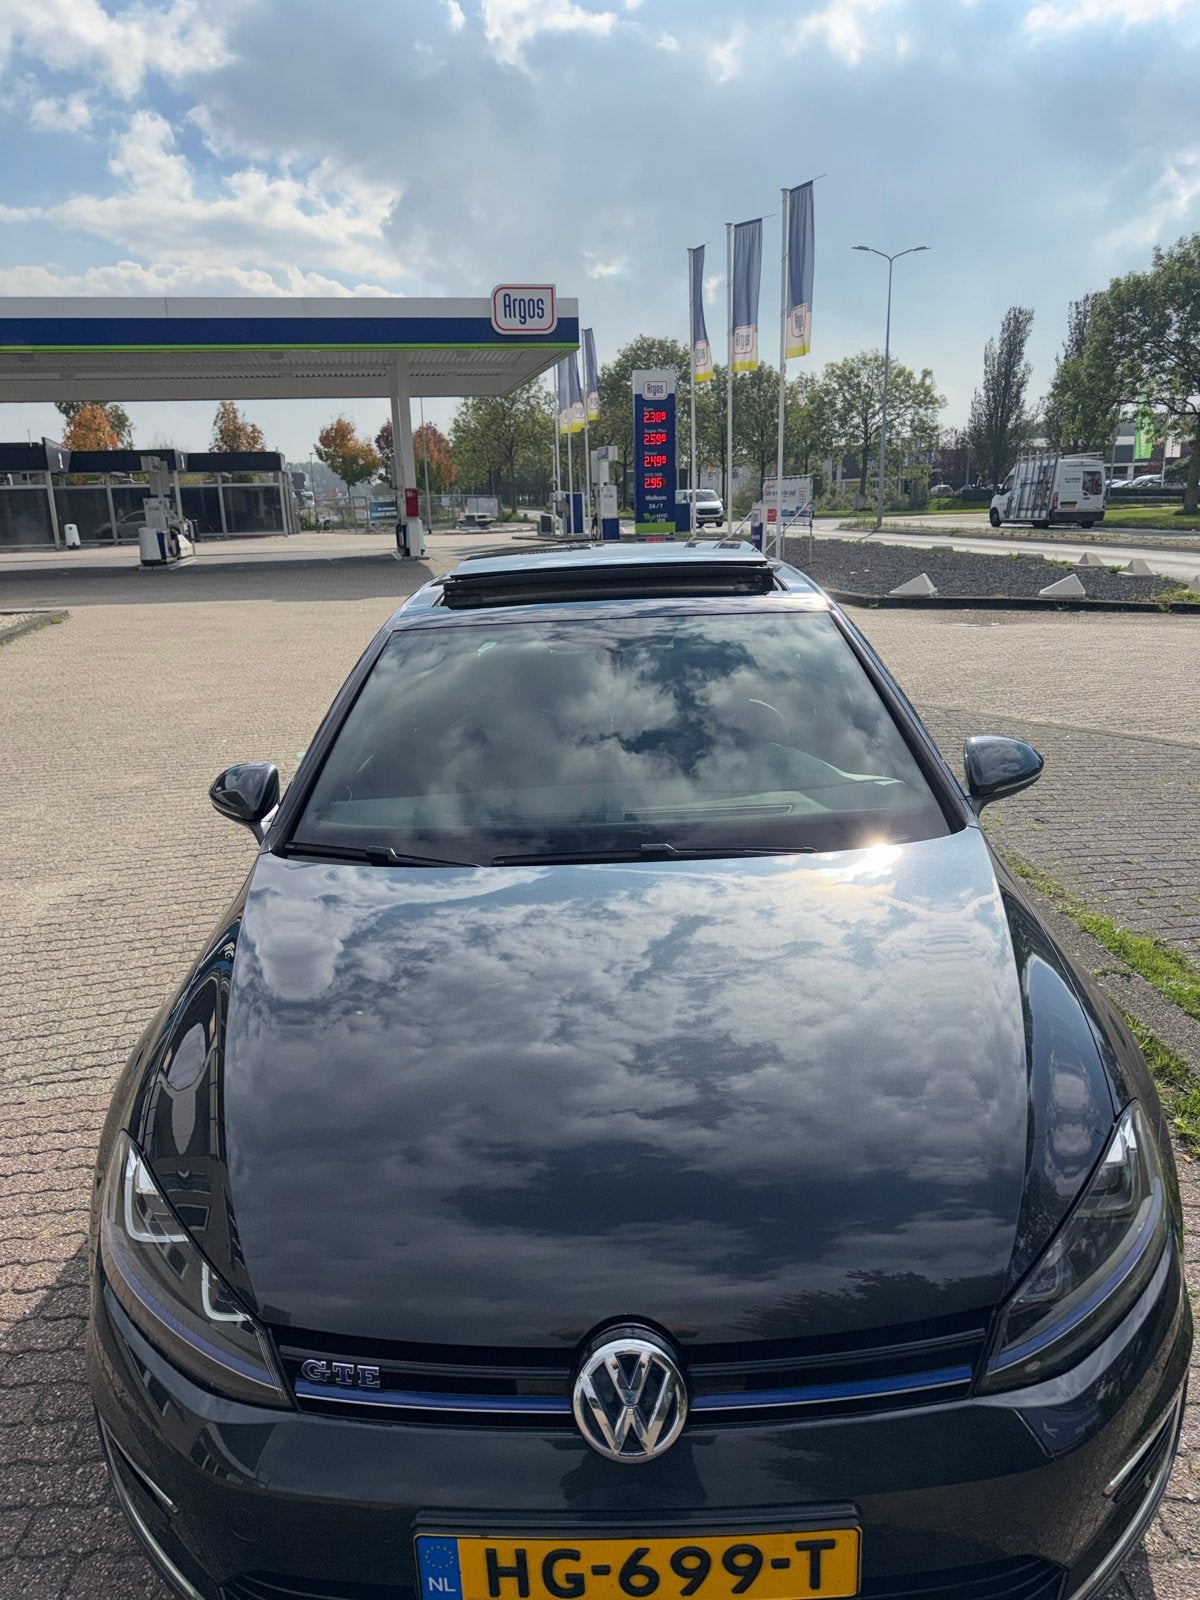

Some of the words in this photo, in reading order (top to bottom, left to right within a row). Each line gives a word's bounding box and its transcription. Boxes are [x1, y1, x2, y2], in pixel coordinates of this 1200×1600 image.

[503, 293, 544, 325] Argos
[647, 384, 664, 396] Argos
[301, 1359, 381, 1388] GTE
[485, 1538, 837, 1599] HG-699-T
[428, 1576, 457, 1593] NL
